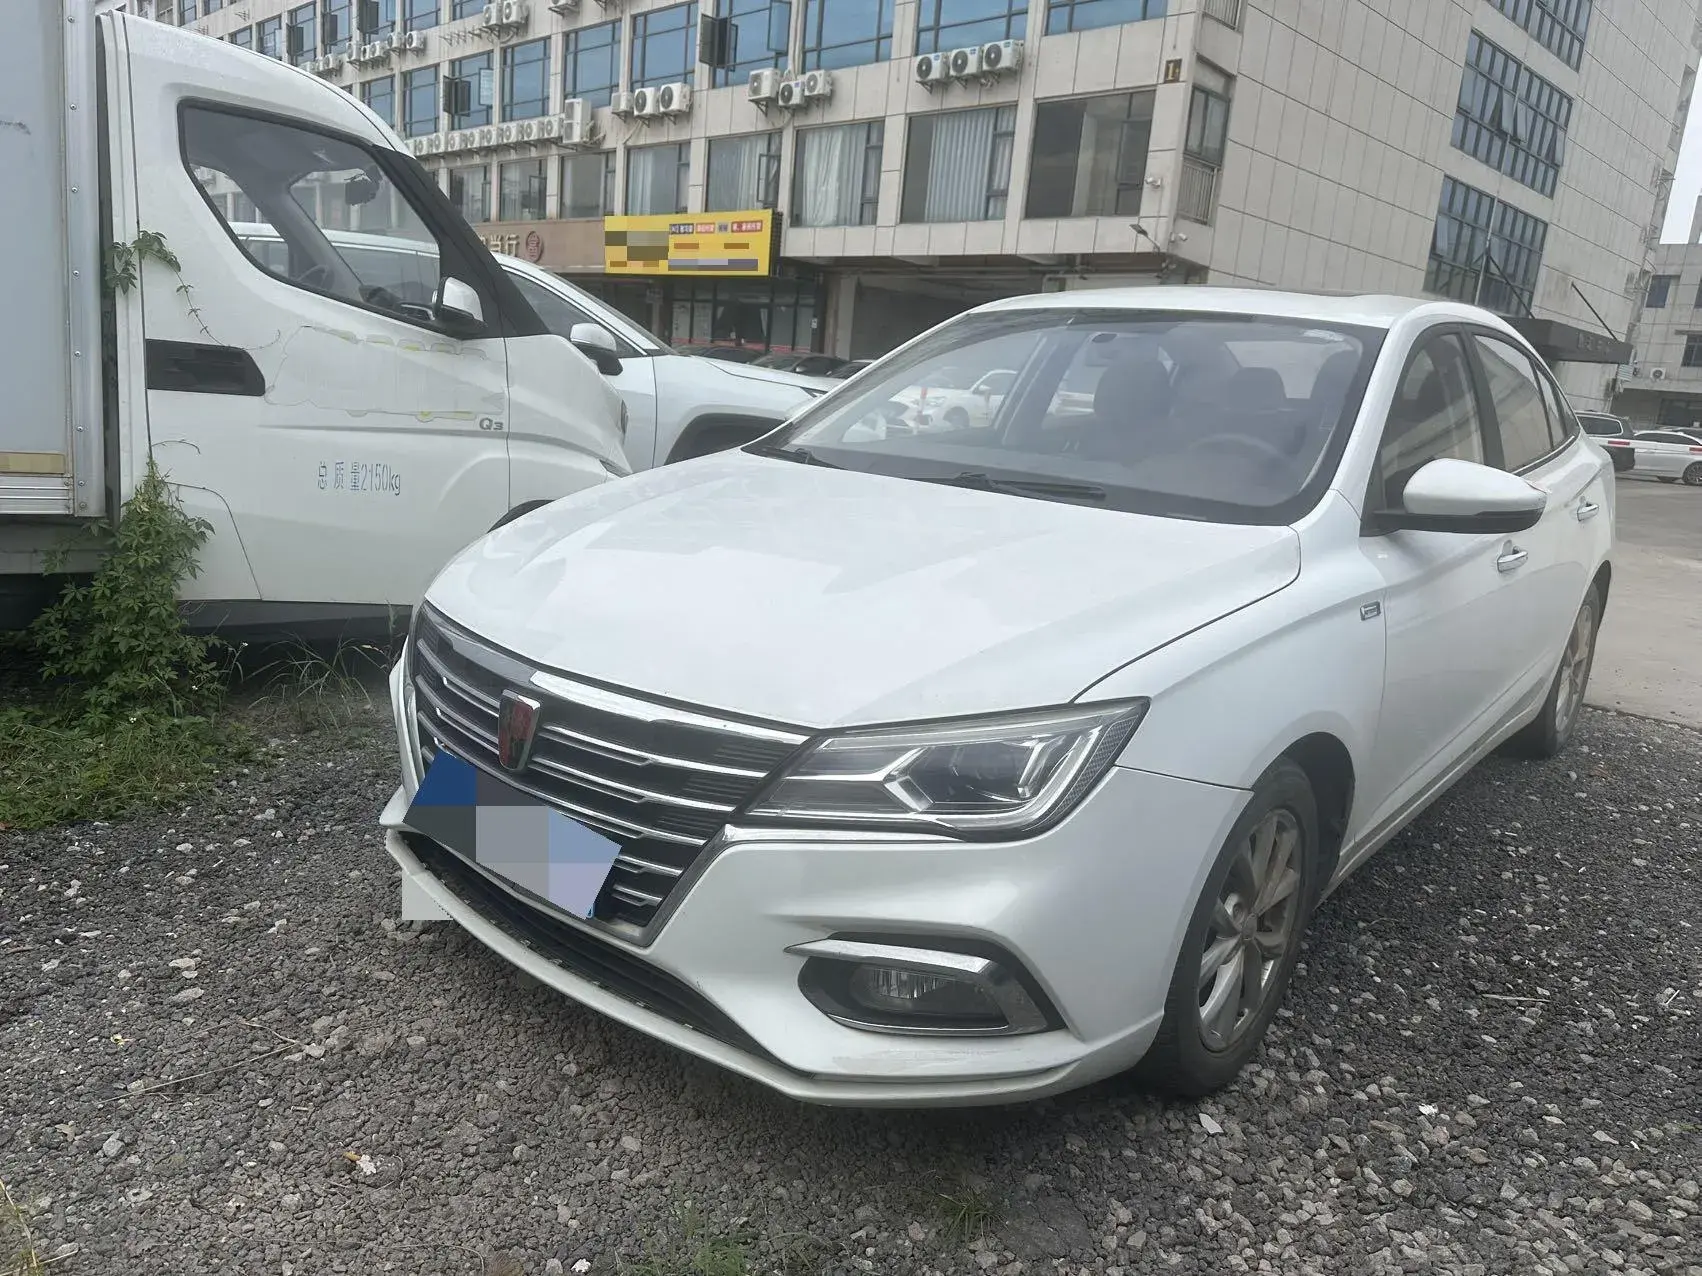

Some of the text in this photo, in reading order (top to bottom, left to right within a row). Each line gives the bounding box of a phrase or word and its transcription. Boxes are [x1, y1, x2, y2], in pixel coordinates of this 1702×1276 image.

[480, 234, 517, 257] 当行
[479, 417, 504, 431] Q3
[317, 460, 401, 496] 总质量2150kg
